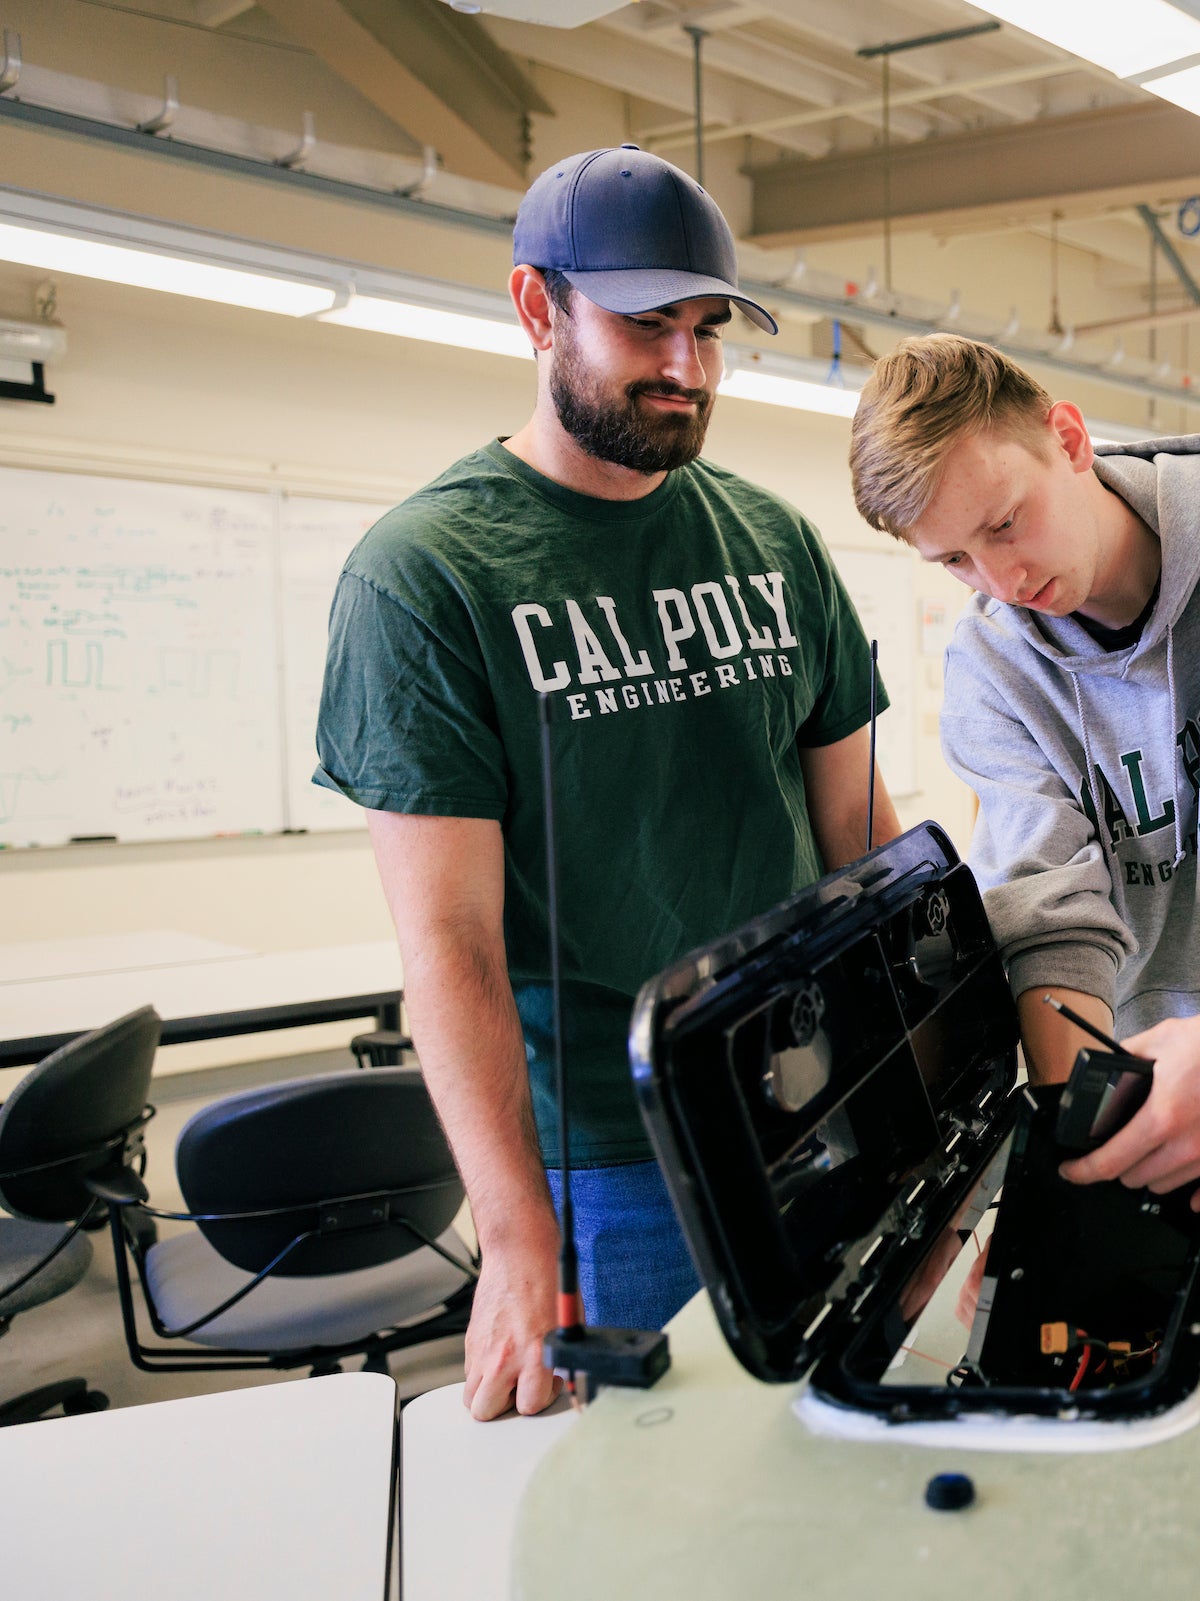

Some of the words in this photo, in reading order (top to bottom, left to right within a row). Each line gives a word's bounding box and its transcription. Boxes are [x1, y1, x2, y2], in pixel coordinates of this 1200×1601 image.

[511, 596, 655, 693] CAL
[652, 571, 799, 672] POLY
[566, 654, 794, 721] ENGINEERING
